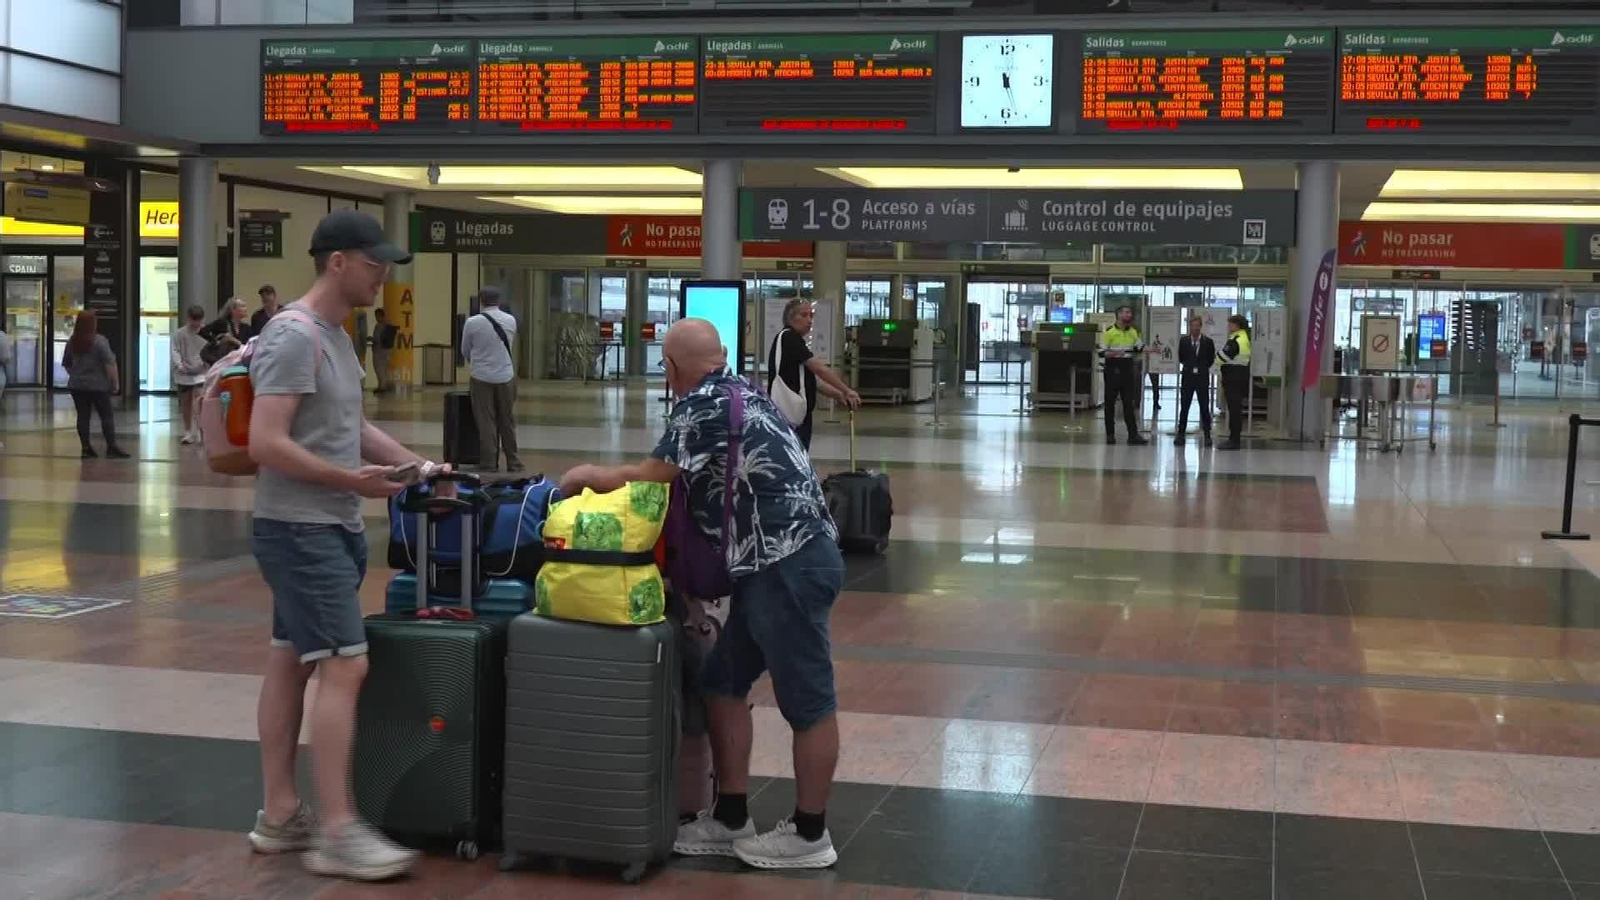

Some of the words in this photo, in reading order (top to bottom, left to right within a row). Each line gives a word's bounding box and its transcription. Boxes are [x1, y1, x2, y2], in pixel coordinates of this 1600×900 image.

[1086, 37, 1125, 48] Salidas
[1298, 36, 1325, 46] adif
[1343, 34, 1386, 45] Salidas
[442, 45, 465, 53] adif
[480, 43, 524, 55] Llegadas
[666, 42, 690, 51] adif
[707, 40, 752, 53] Llegadas
[902, 41, 928, 50] adif
[1001, 45, 1015, 55] 12
[266, 46, 307, 57] Llegadas
[970, 77, 980, 86] 9
[1034, 76, 1043, 86] 3
[1367, 91, 1398, 99] SEVILLA
[1425, 91, 1447, 99] JUSTA
[1001, 109, 1010, 118] 6
[1106, 110, 1137, 118] SEVILLA
[862, 199, 918, 215] Acceso
[925, 203, 934, 215] a
[942, 199, 976, 215] vías
[1042, 201, 1106, 217] Control
[1112, 201, 1136, 217] de
[1142, 202, 1233, 220] equipajes
[146, 210, 179, 224] Her
[803, 199, 850, 229] 1-8
[456, 221, 514, 236] Llegadas
[862, 220, 928, 230] PLATFORMS
[1042, 221, 1098, 232] LUGGAGE
[1101, 221, 1156, 232] CONTROL
[646, 223, 664, 236] No
[669, 224, 701, 241] pasa
[1382, 230, 1403, 245] No
[1408, 231, 1453, 249] pasar
[399, 289, 413, 350] ATM
[1313, 295, 1324, 352] renfe
